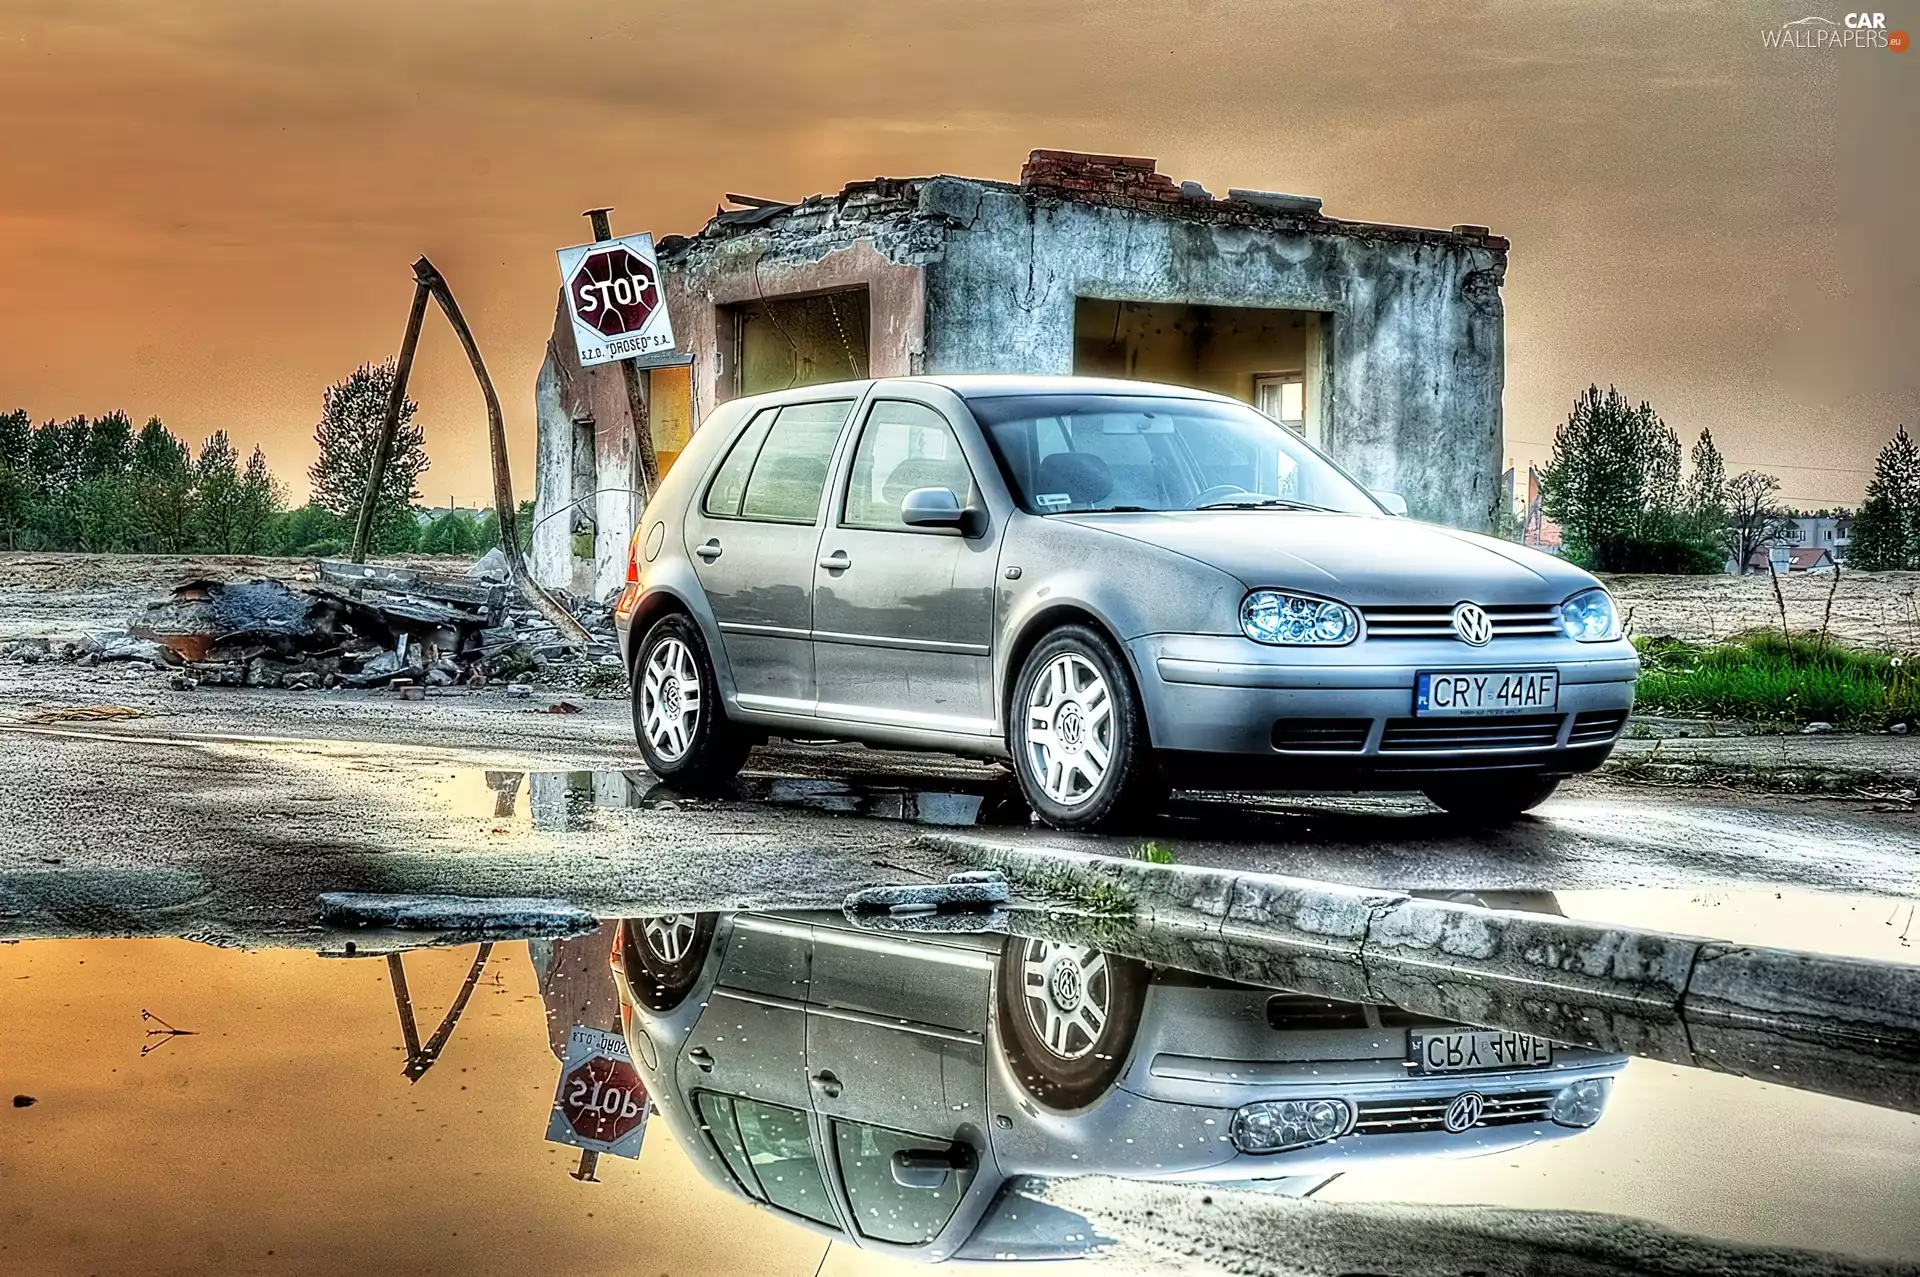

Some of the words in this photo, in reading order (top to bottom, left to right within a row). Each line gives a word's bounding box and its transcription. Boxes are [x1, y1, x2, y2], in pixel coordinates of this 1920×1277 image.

[580, 274, 649, 312] STOP
[1434, 677, 1488, 707] CRY
[1497, 675, 1554, 706] 44AF
